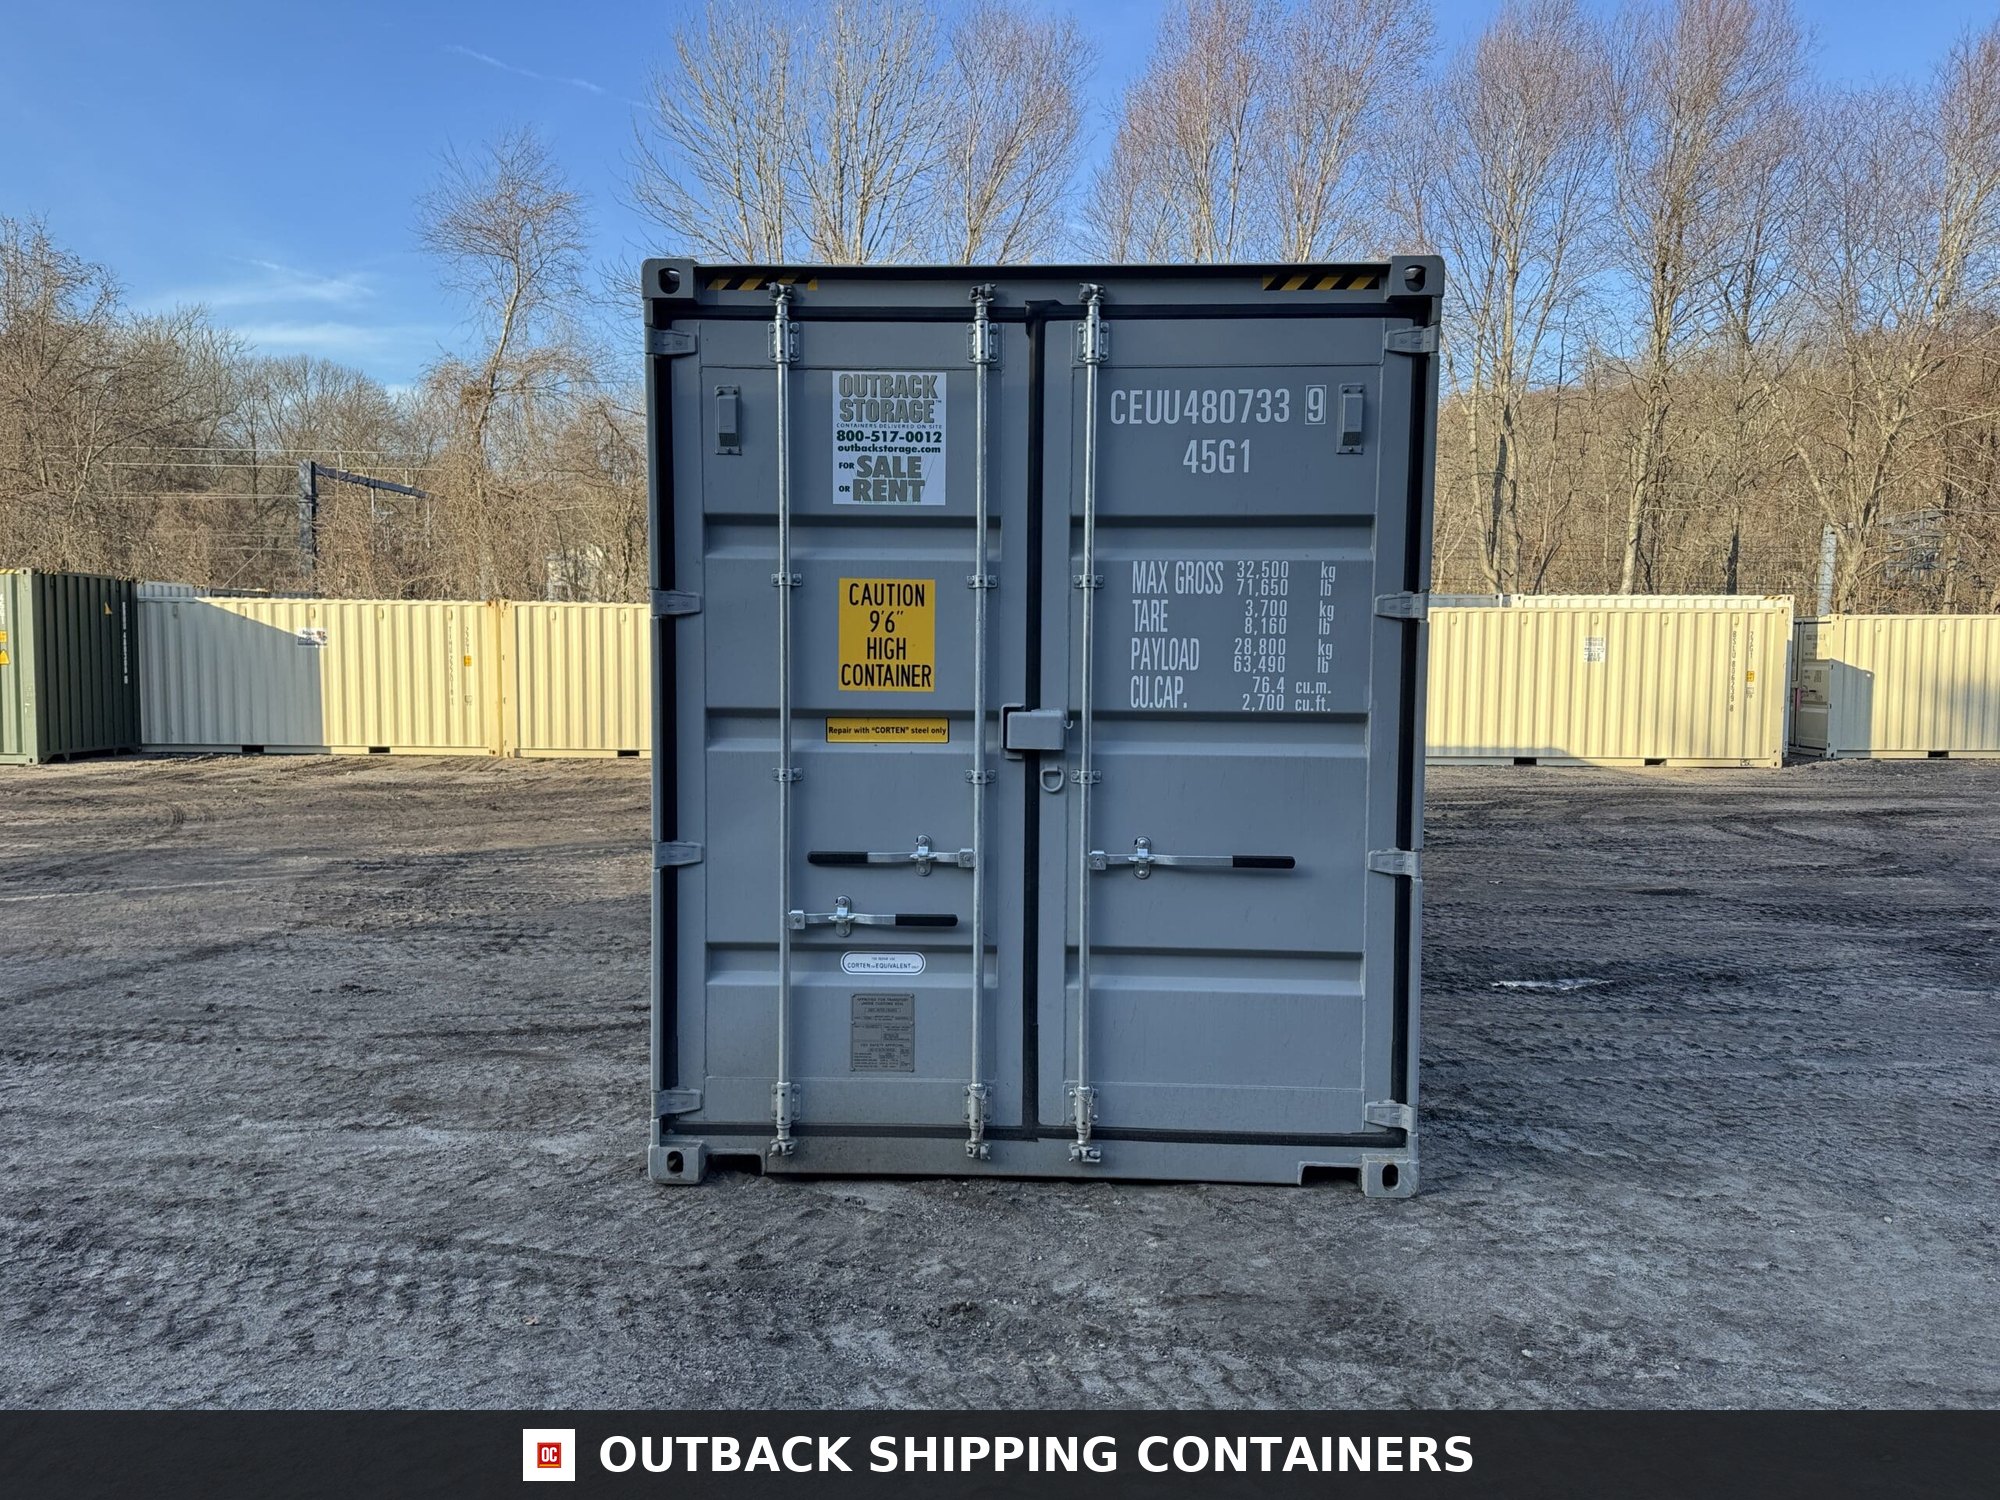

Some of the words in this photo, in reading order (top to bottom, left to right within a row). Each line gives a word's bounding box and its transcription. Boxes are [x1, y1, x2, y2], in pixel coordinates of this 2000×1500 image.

[838, 374, 938, 399] OUTBACK
[1110, 388, 1290, 424] CEUU480733
[1308, 387, 1324, 422] 9
[836, 430, 942, 443] 800-517-0012
[838, 444, 941, 454] outbackstorage.com
[1183, 439, 1250, 474] 45G1
[856, 455, 922, 478] SALE
[853, 479, 925, 502] RENT
[1132, 561, 1168, 594] MAX
[1175, 561, 1224, 594] GROSS
[1236, 560, 1289, 579] 32,500
[1321, 561, 1336, 582] kg
[1236, 578, 1288, 597] 71,650
[1320, 579, 1332, 596] lb
[849, 583, 925, 607] CAUTION
[1132, 600, 1168, 633] TARE
[1245, 600, 1287, 618] 3,700
[1319, 600, 1334, 621] kg
[1244, 618, 1287, 636] 8,160
[1318, 618, 1330, 635] lb
[867, 637, 906, 660] HIGH
[1131, 637, 1200, 671] PAYLOAD
[1234, 638, 1286, 657] 28,800
[1318, 639, 1333, 660] kg
[841, 664, 932, 687] CONTAINER
[1233, 656, 1286, 674] 63,490
[1317, 657, 1329, 674] lb
[1130, 675, 1187, 709] CU.CAP.
[1252, 676, 1285, 694] 76.4
[1295, 681, 1332, 695] cu.m.
[1242, 694, 1284, 712] 2,700
[1295, 697, 1331, 712] cu.ft.
[828, 726, 852, 735] Repair
[931, 727, 946, 736] only
